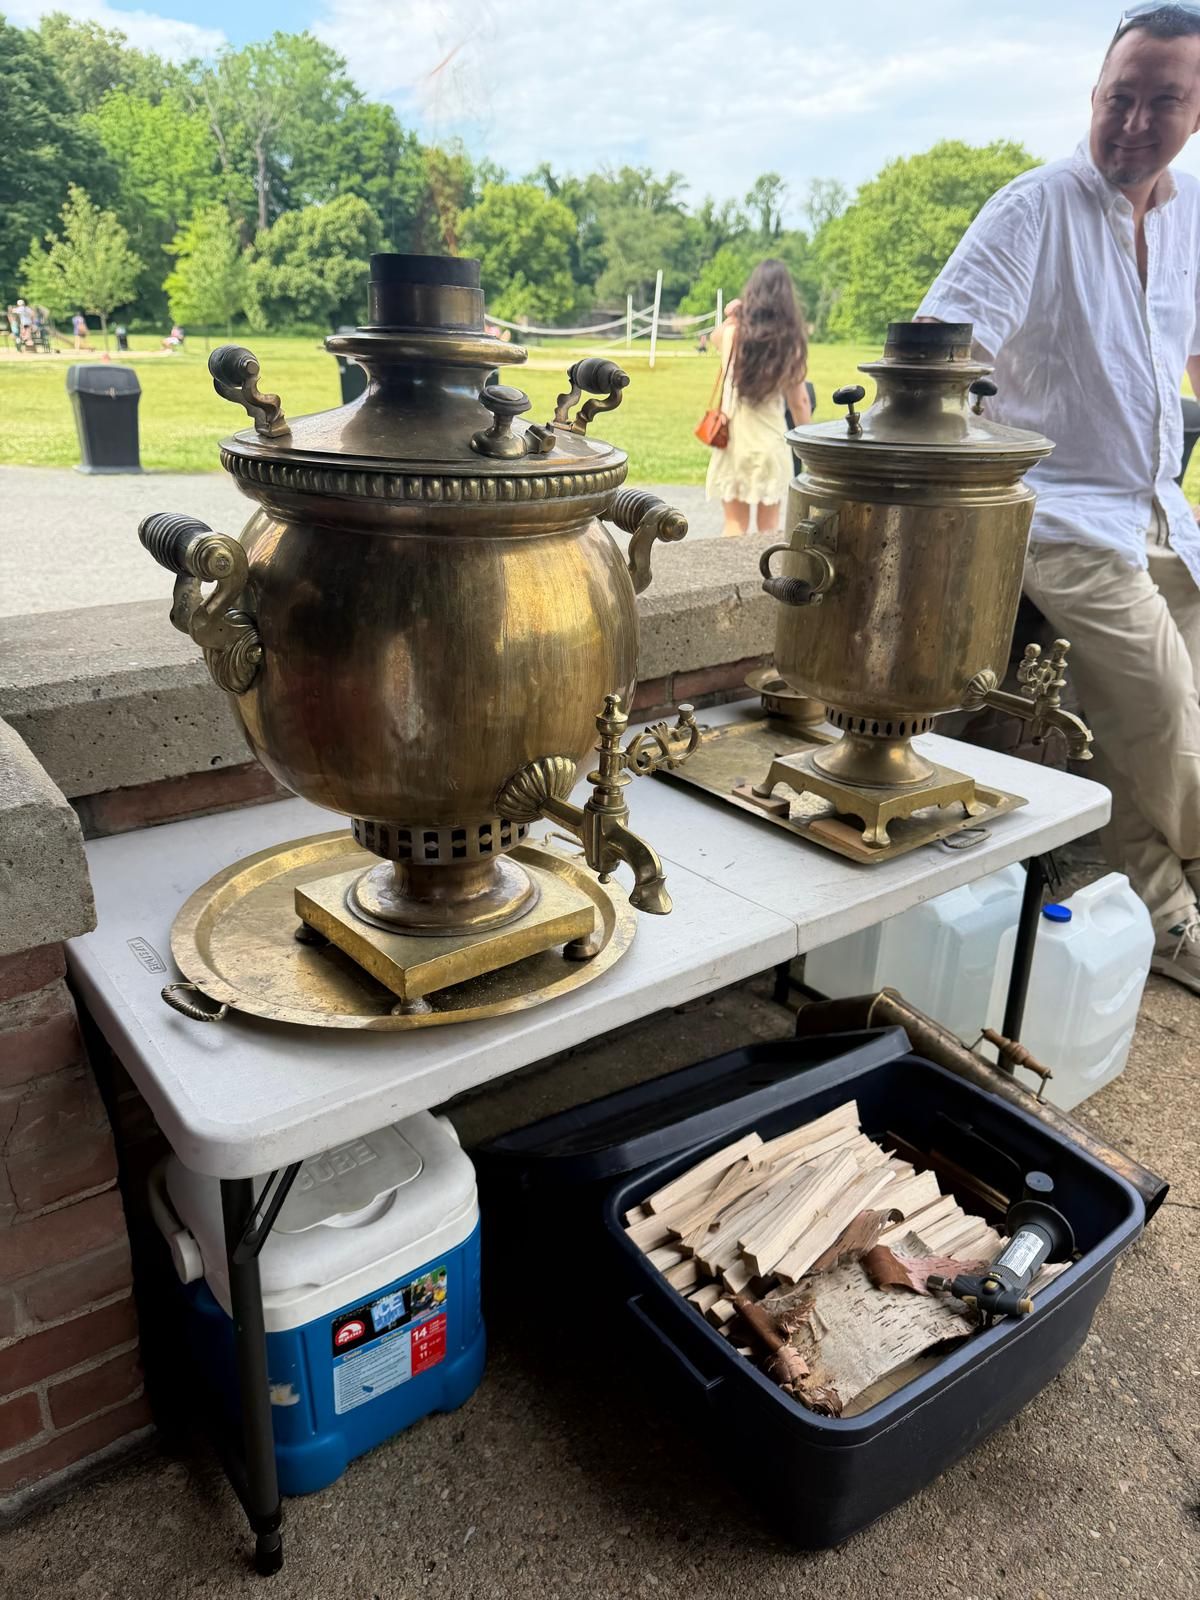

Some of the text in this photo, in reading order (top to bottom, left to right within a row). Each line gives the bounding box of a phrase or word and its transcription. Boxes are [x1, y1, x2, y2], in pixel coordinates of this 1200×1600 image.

[130, 942, 162, 971] LIFETIME
[374, 1295, 403, 1320] ICE
[412, 1326, 428, 1341] 14
[419, 1342, 428, 1352] 12
[419, 1351, 428, 1360] 11
